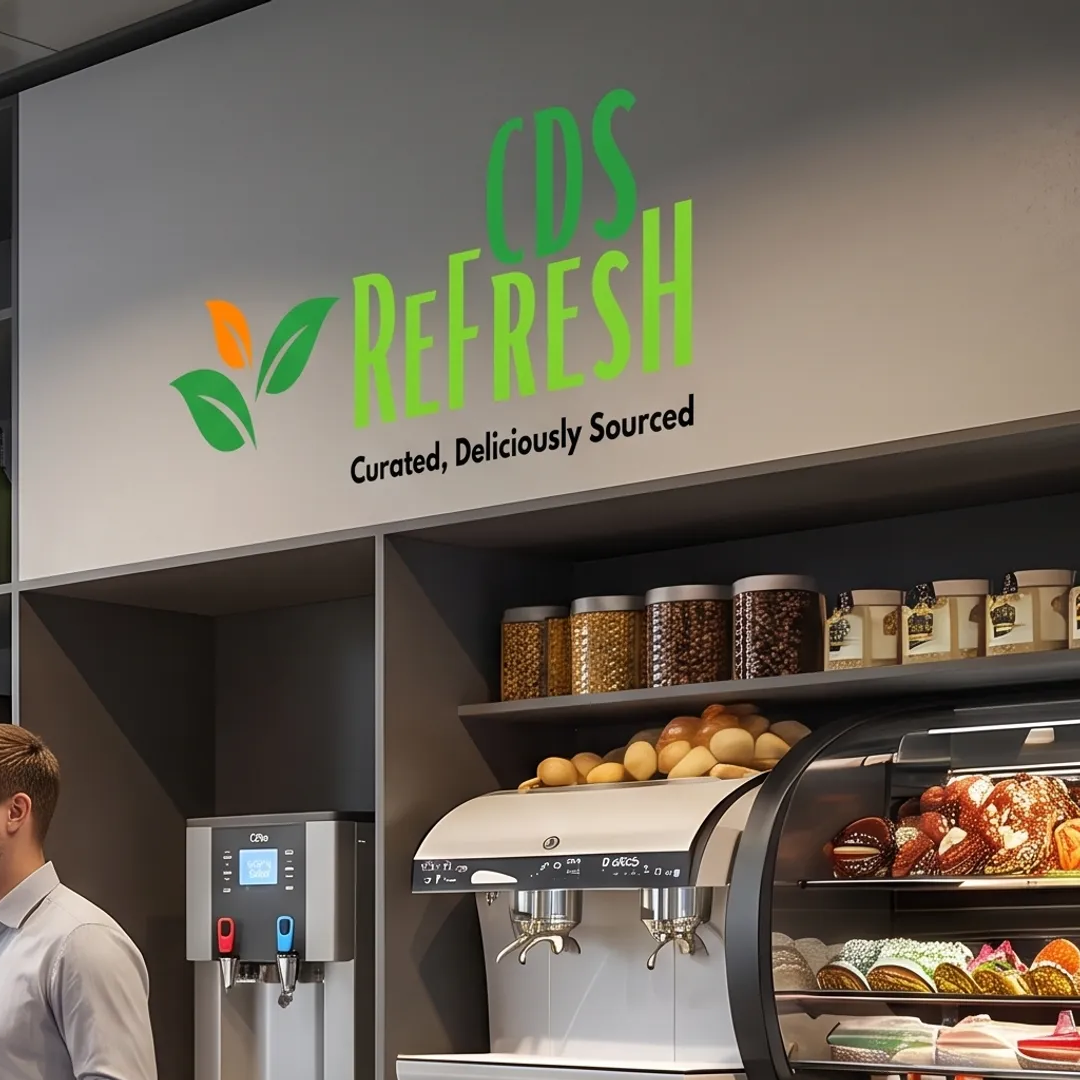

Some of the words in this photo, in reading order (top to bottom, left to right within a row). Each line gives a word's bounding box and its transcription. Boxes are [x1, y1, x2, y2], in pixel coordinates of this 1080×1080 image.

[486, 88, 637, 264] CDS
[350, 441, 448, 484] Curated,
[455, 420, 583, 467] Deliciously
[589, 394, 695, 444] Sourced
